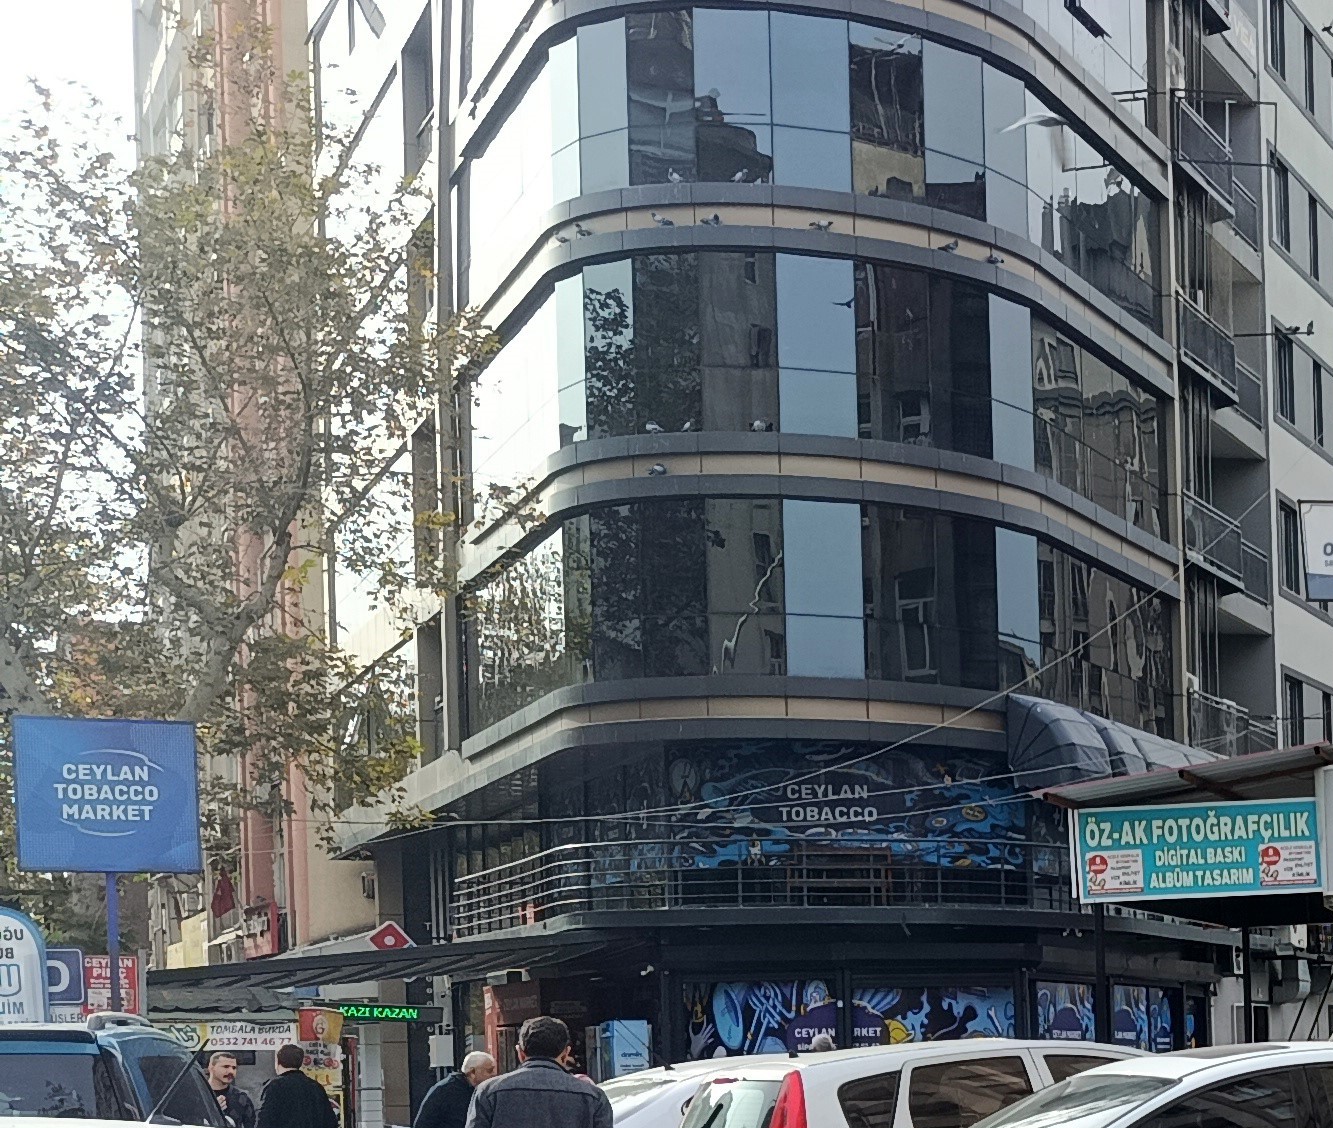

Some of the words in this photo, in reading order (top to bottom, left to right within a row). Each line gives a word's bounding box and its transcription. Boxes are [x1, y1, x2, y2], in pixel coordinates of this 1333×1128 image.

[62, 763, 149, 782] CEYLAN
[53, 783, 159, 802] TOBACCO
[786, 784, 868, 799] CEYLAN
[62, 804, 153, 821] MARKET
[778, 806, 878, 821] TOBACCO
[1086, 816, 1148, 848] ÖZ-AK
[1152, 810, 1310, 844] FOTOĞRAFÇILIK
[1155, 846, 1205, 867] DİGİTAL
[1206, 847, 1246, 865] BASKI
[1150, 868, 1194, 890] ALBÜM
[1196, 867, 1254, 887] TASARIM
[339, 1006, 370, 1017] KAZI
[373, 1007, 419, 1019] KAZAN
[210, 1025, 255, 1035] TOMBALA
[210, 1037, 238, 1047] 0532
[241, 1037, 258, 1047] 741
[261, 1037, 276, 1046] 46
